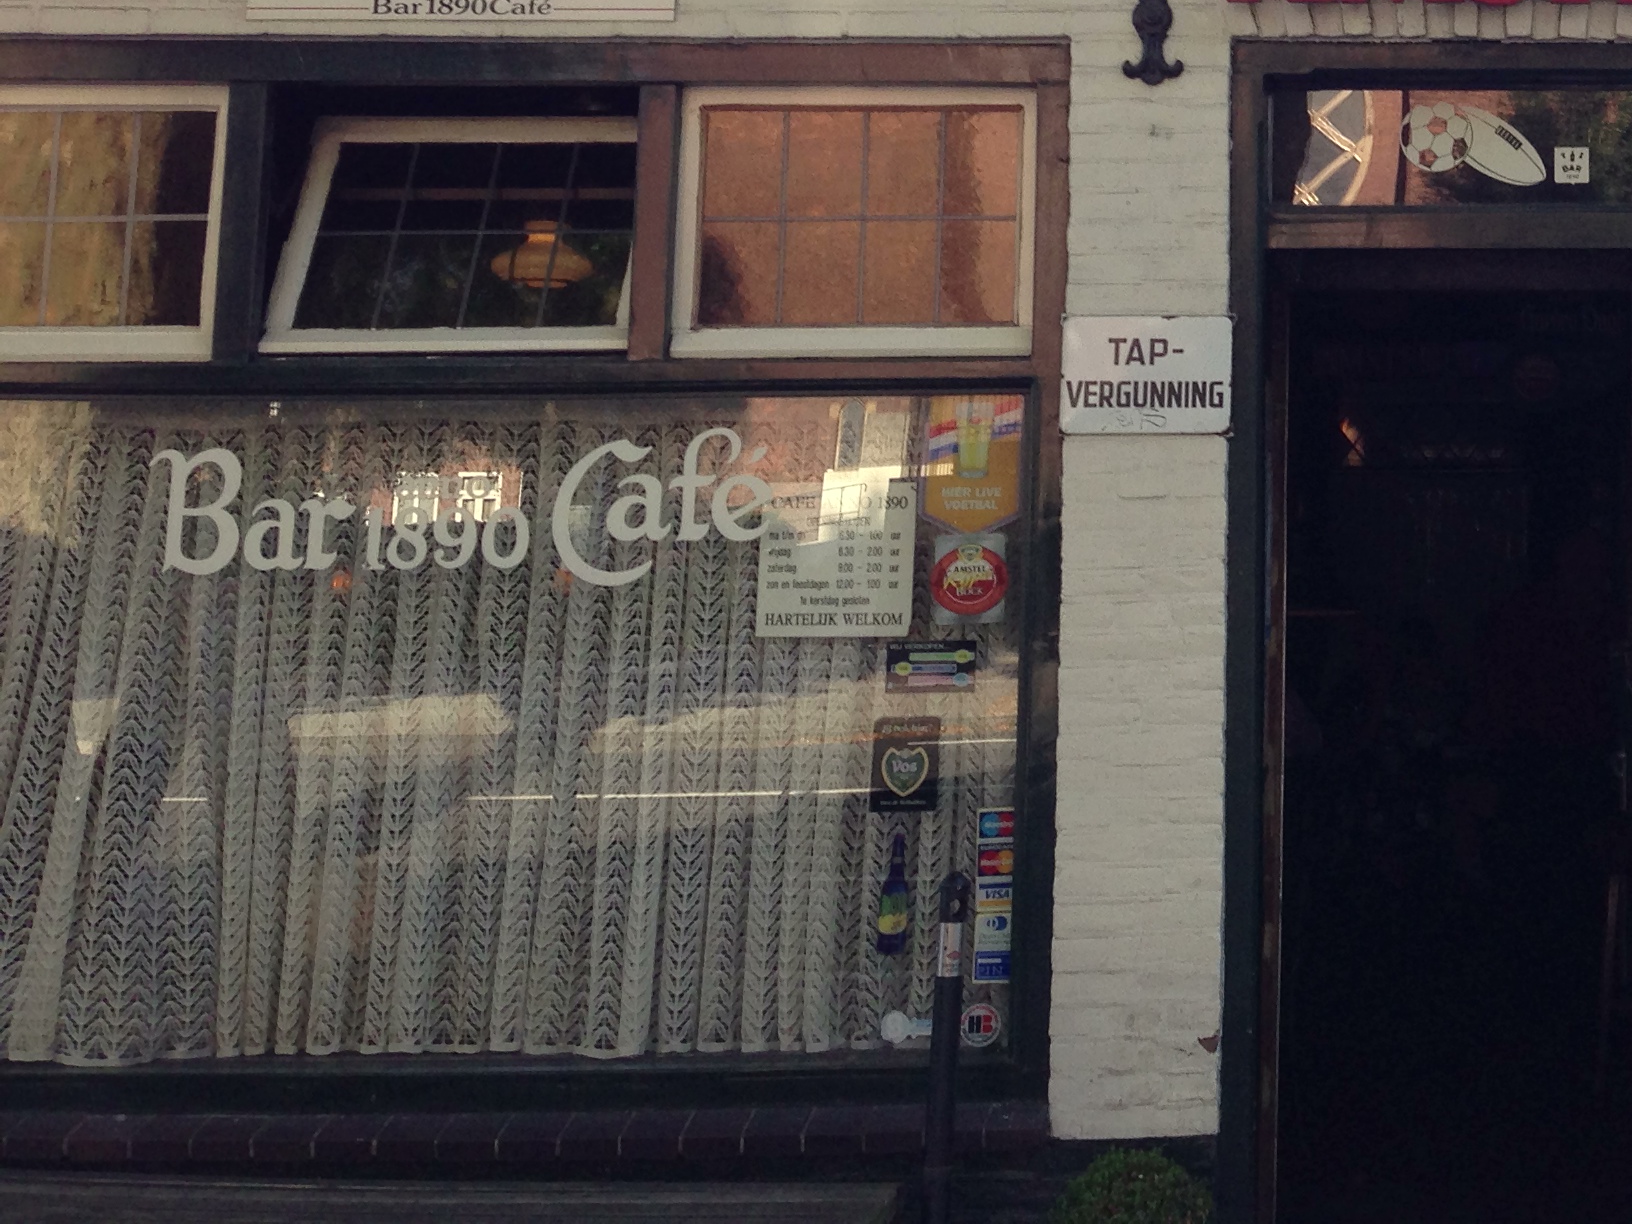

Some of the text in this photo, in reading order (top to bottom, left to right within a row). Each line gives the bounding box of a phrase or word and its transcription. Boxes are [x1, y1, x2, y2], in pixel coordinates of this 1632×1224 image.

[1108, 337, 1184, 366] TAP-
[1066, 380, 1224, 408] VERGUNNING
[975, 487, 1002, 497] LIVE
[552, 426, 774, 587] Café
[877, 495, 909, 509] 1890
[150, 447, 356, 574] Bar
[362, 507, 529, 570] 1890
[954, 565, 986, 573] AMSTEL
[765, 613, 903, 626] HARTELIJK WELKOM
[985, 889, 1010, 898] VISA
[980, 966, 1003, 976] PIN
